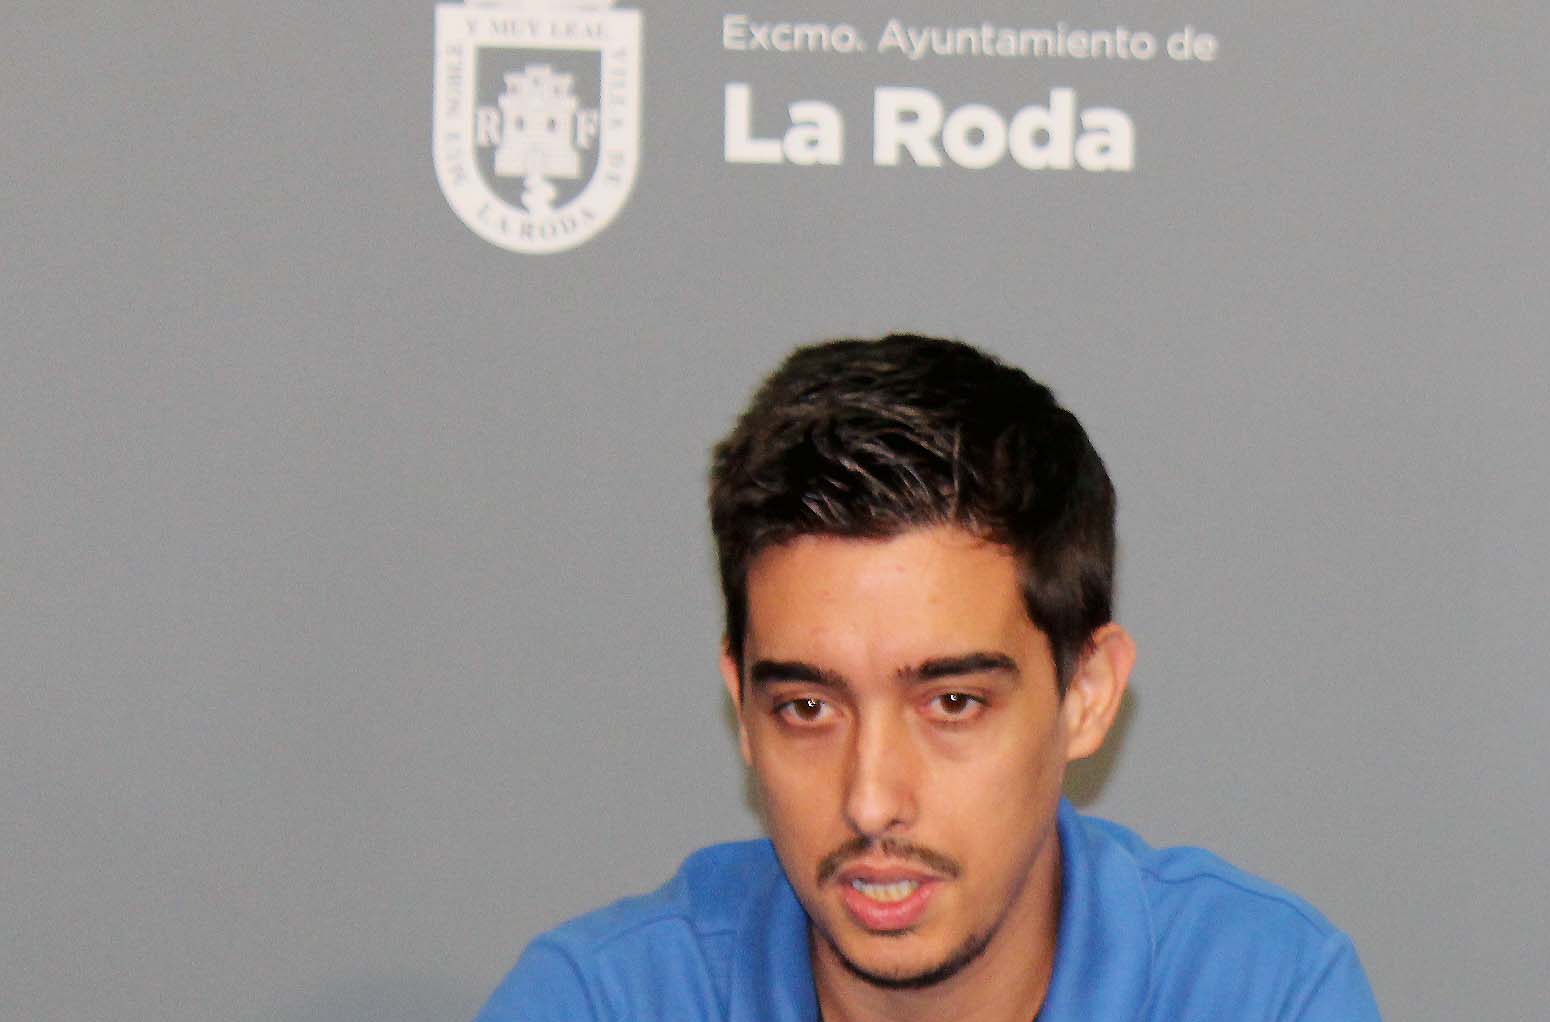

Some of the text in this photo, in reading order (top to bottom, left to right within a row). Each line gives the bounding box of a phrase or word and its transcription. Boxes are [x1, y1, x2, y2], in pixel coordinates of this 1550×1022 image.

[721, 14, 1219, 62] Excmo. Ayuntamiento de
[723, 81, 1135, 172] La Roda
